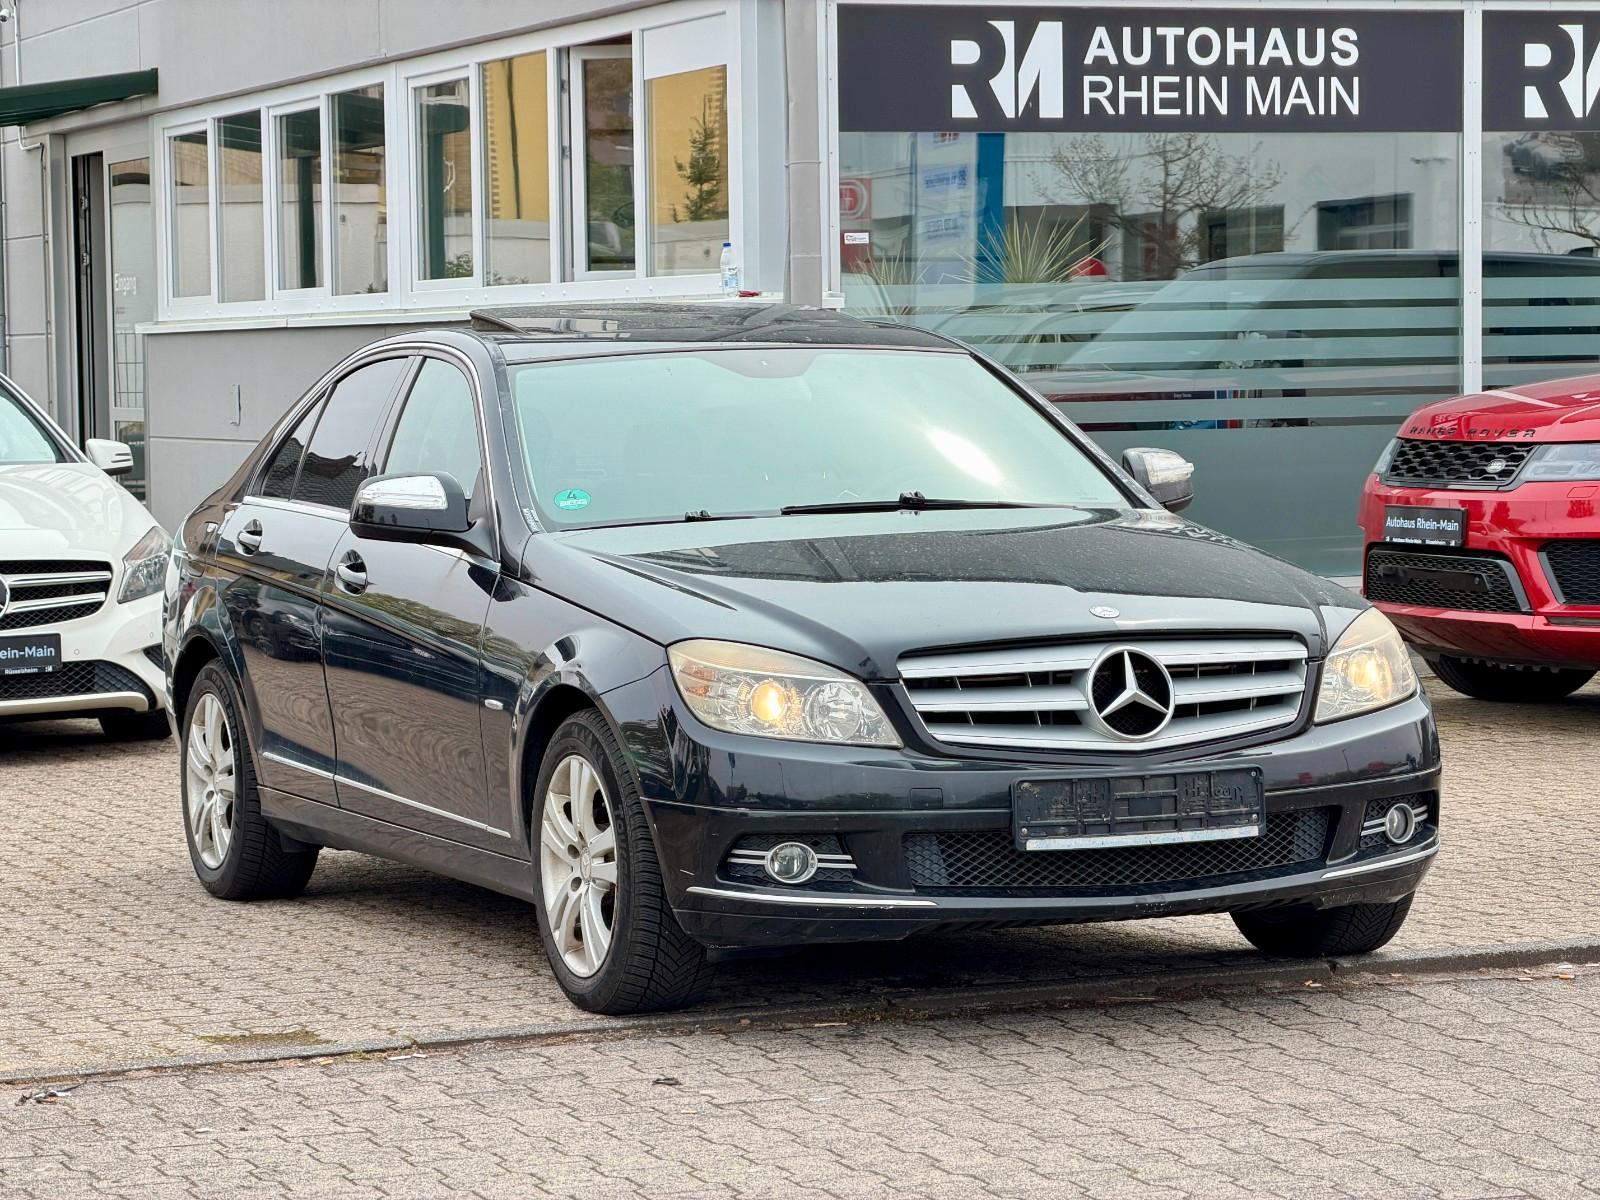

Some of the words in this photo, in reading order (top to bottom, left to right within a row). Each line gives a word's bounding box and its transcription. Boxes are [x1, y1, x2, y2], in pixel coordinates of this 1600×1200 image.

[1084, 27, 1358, 66] AUTOHAUS
[951, 21, 1063, 118] RM
[1084, 76, 1227, 115] RHEIN
[1247, 77, 1359, 115] MAIN
[1409, 427, 1457, 436] RANGE
[1467, 429, 1536, 438] ROVER
[567, 490, 577, 499] 4
[1386, 516, 1415, 528] Autohaus
[1416, 518, 1459, 531] Rhein-Main
